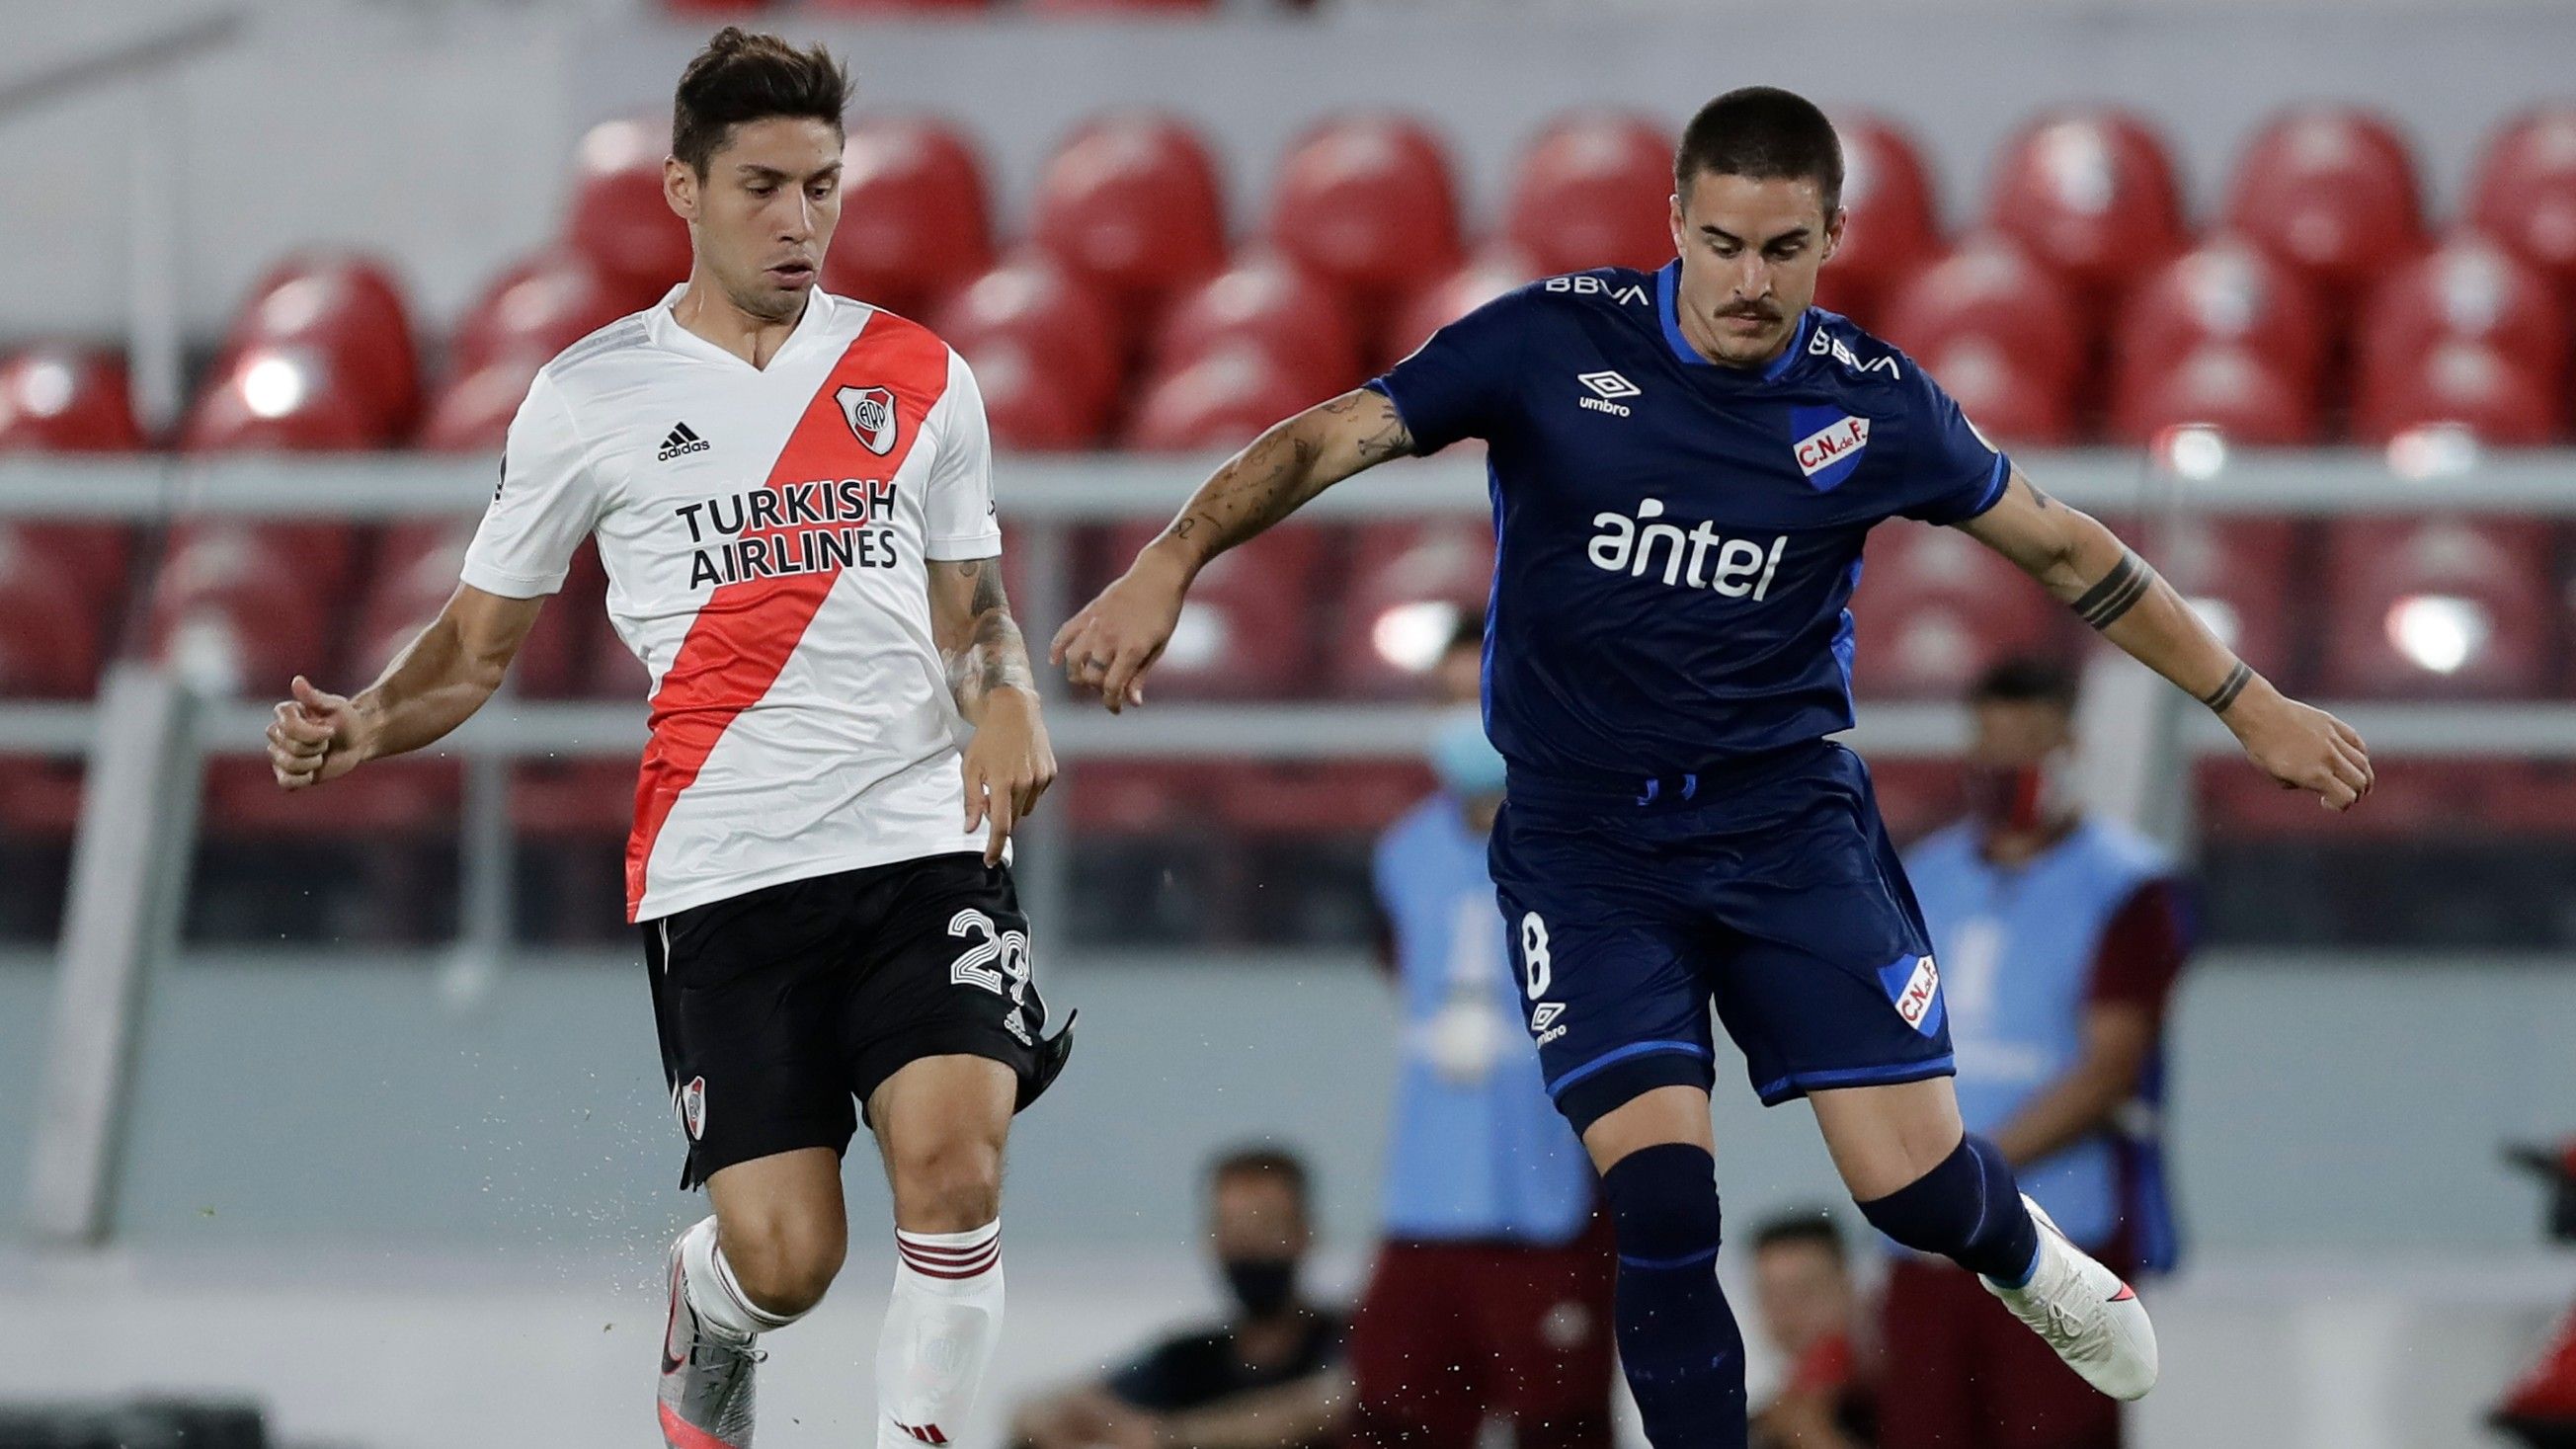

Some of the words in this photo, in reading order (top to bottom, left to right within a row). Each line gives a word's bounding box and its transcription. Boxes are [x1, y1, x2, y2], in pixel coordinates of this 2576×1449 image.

[1546, 276, 1649, 305] BBVA
[1809, 325, 1899, 380] BBVA
[1579, 396, 1630, 418] umbro
[657, 439, 710, 461] adidas
[676, 481, 897, 543] TURKISH
[688, 530, 897, 591] AIRLINES
[1587, 498, 1788, 602] antel
[948, 908, 1028, 1006] 29
